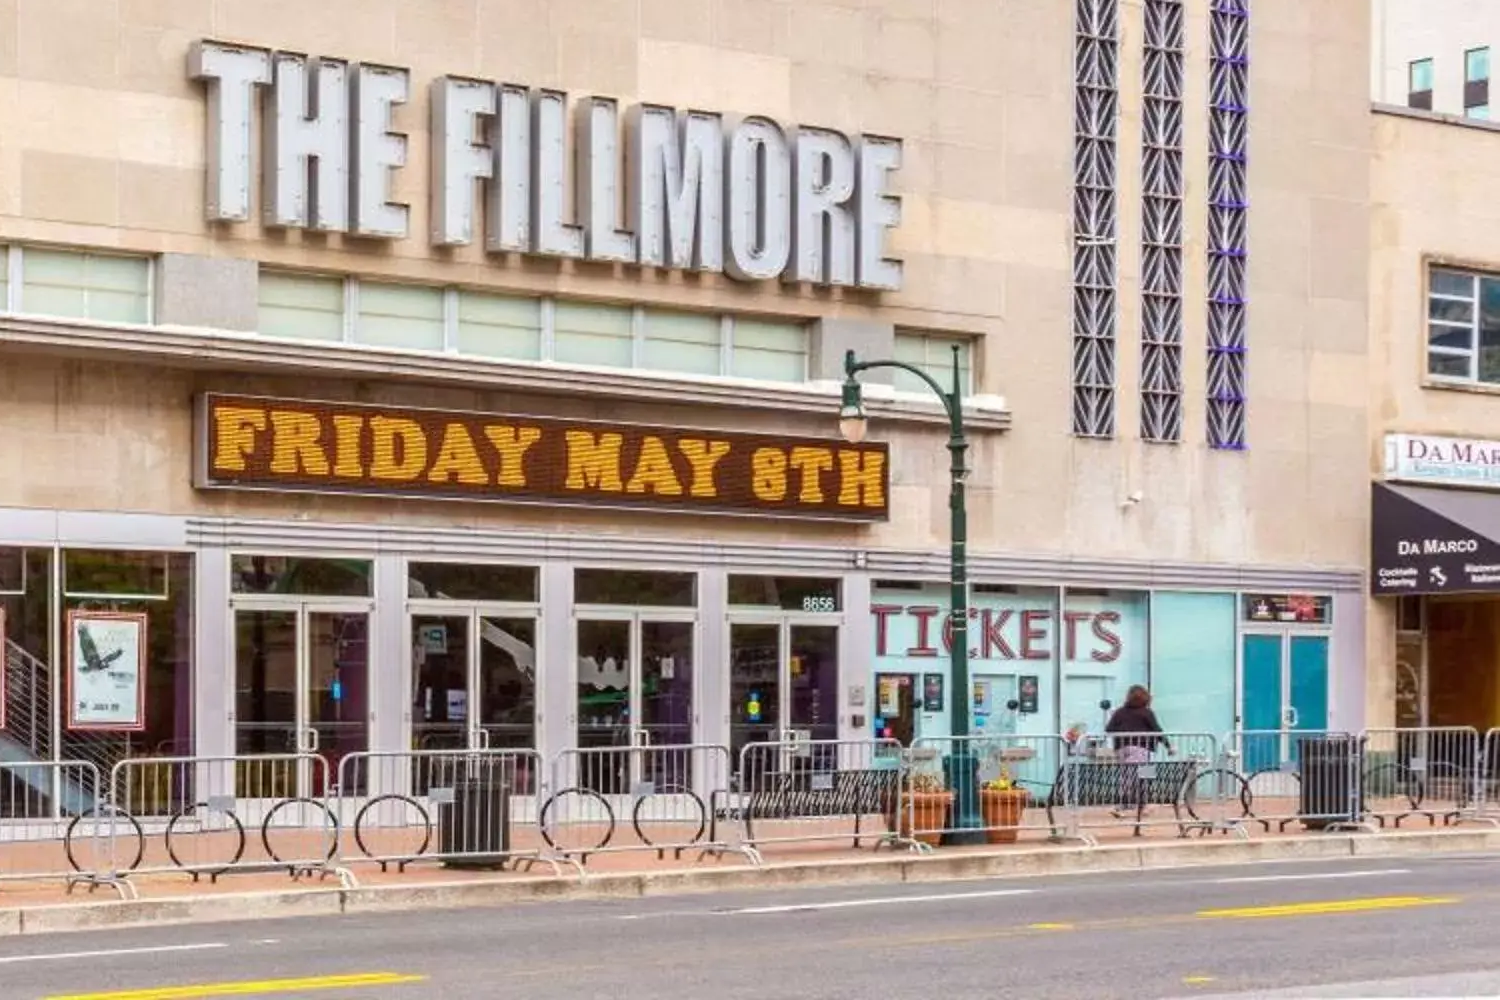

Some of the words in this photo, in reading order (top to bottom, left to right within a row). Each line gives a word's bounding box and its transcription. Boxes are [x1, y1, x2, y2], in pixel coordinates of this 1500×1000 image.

[188, 39, 410, 238] THE
[431, 75, 904, 290] FILLMORE
[215, 405, 542, 486] FRIDAY
[565, 429, 731, 497] MAY
[752, 446, 885, 508] 8TH
[1398, 541, 1420, 555] DA
[1423, 539, 1478, 554] MARCO
[803, 596, 835, 612] 8656
[870, 604, 1122, 663] TICKETS
